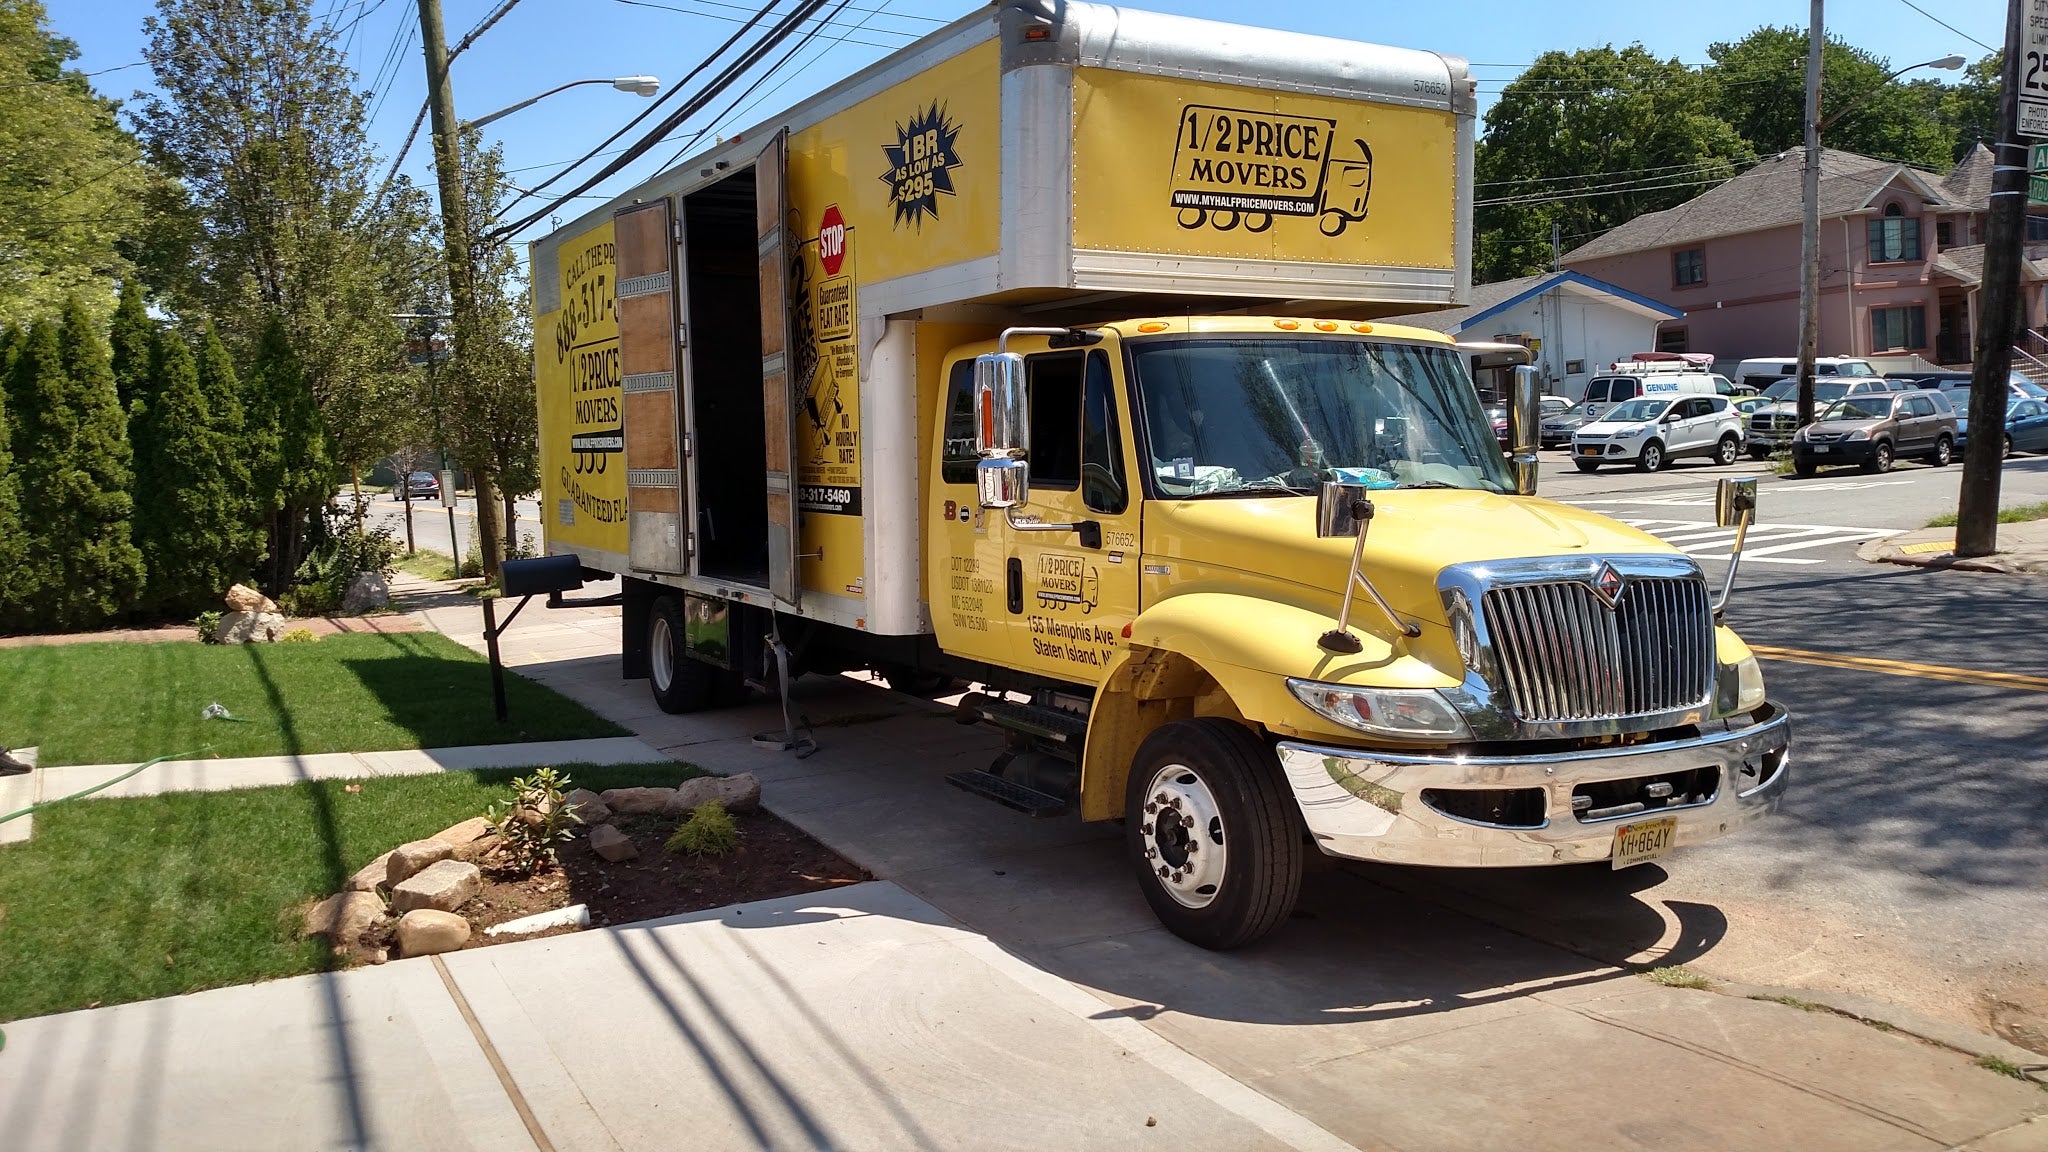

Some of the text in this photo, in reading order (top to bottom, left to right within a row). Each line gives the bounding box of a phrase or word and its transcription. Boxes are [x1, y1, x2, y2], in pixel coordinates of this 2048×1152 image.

[1413, 79, 1447, 96] 576652
[2028, 106, 2048, 118] PHOTO
[1188, 112, 1321, 162] 1/2 PRICE
[895, 152, 945, 182] AS LOW AS
[1189, 158, 1307, 190] MOVERS
[898, 172, 934, 203] $295
[1175, 193, 1315, 214] WWW.MYHALFPRICEMOVERS.COM
[820, 224, 844, 259] STOP
[566, 254, 585, 290] CALL
[586, 243, 603, 271] THE
[820, 304, 849, 330] FLAT RATE
[572, 348, 621, 393] 1/2 PRICE
[1645, 383, 1679, 392] GENUINE
[575, 397, 618, 425] MOVERS
[841, 413, 850, 430] NO
[836, 431, 858, 447] HOURLY
[839, 448, 855, 464] RATE!
[561, 465, 613, 524] GUARANTEED
[1106, 531, 1135, 548] 576652
[1040, 557, 1081, 578] 1/2 PRICE
[952, 575, 969, 591] USDOT
[1041, 577, 1077, 592] MOVERS
[1027, 615, 1118, 647] 155 Memphis Ave.
[1033, 637, 1113, 670] Staten Island, N
[1626, 853, 1658, 865] COMMERCIAL
